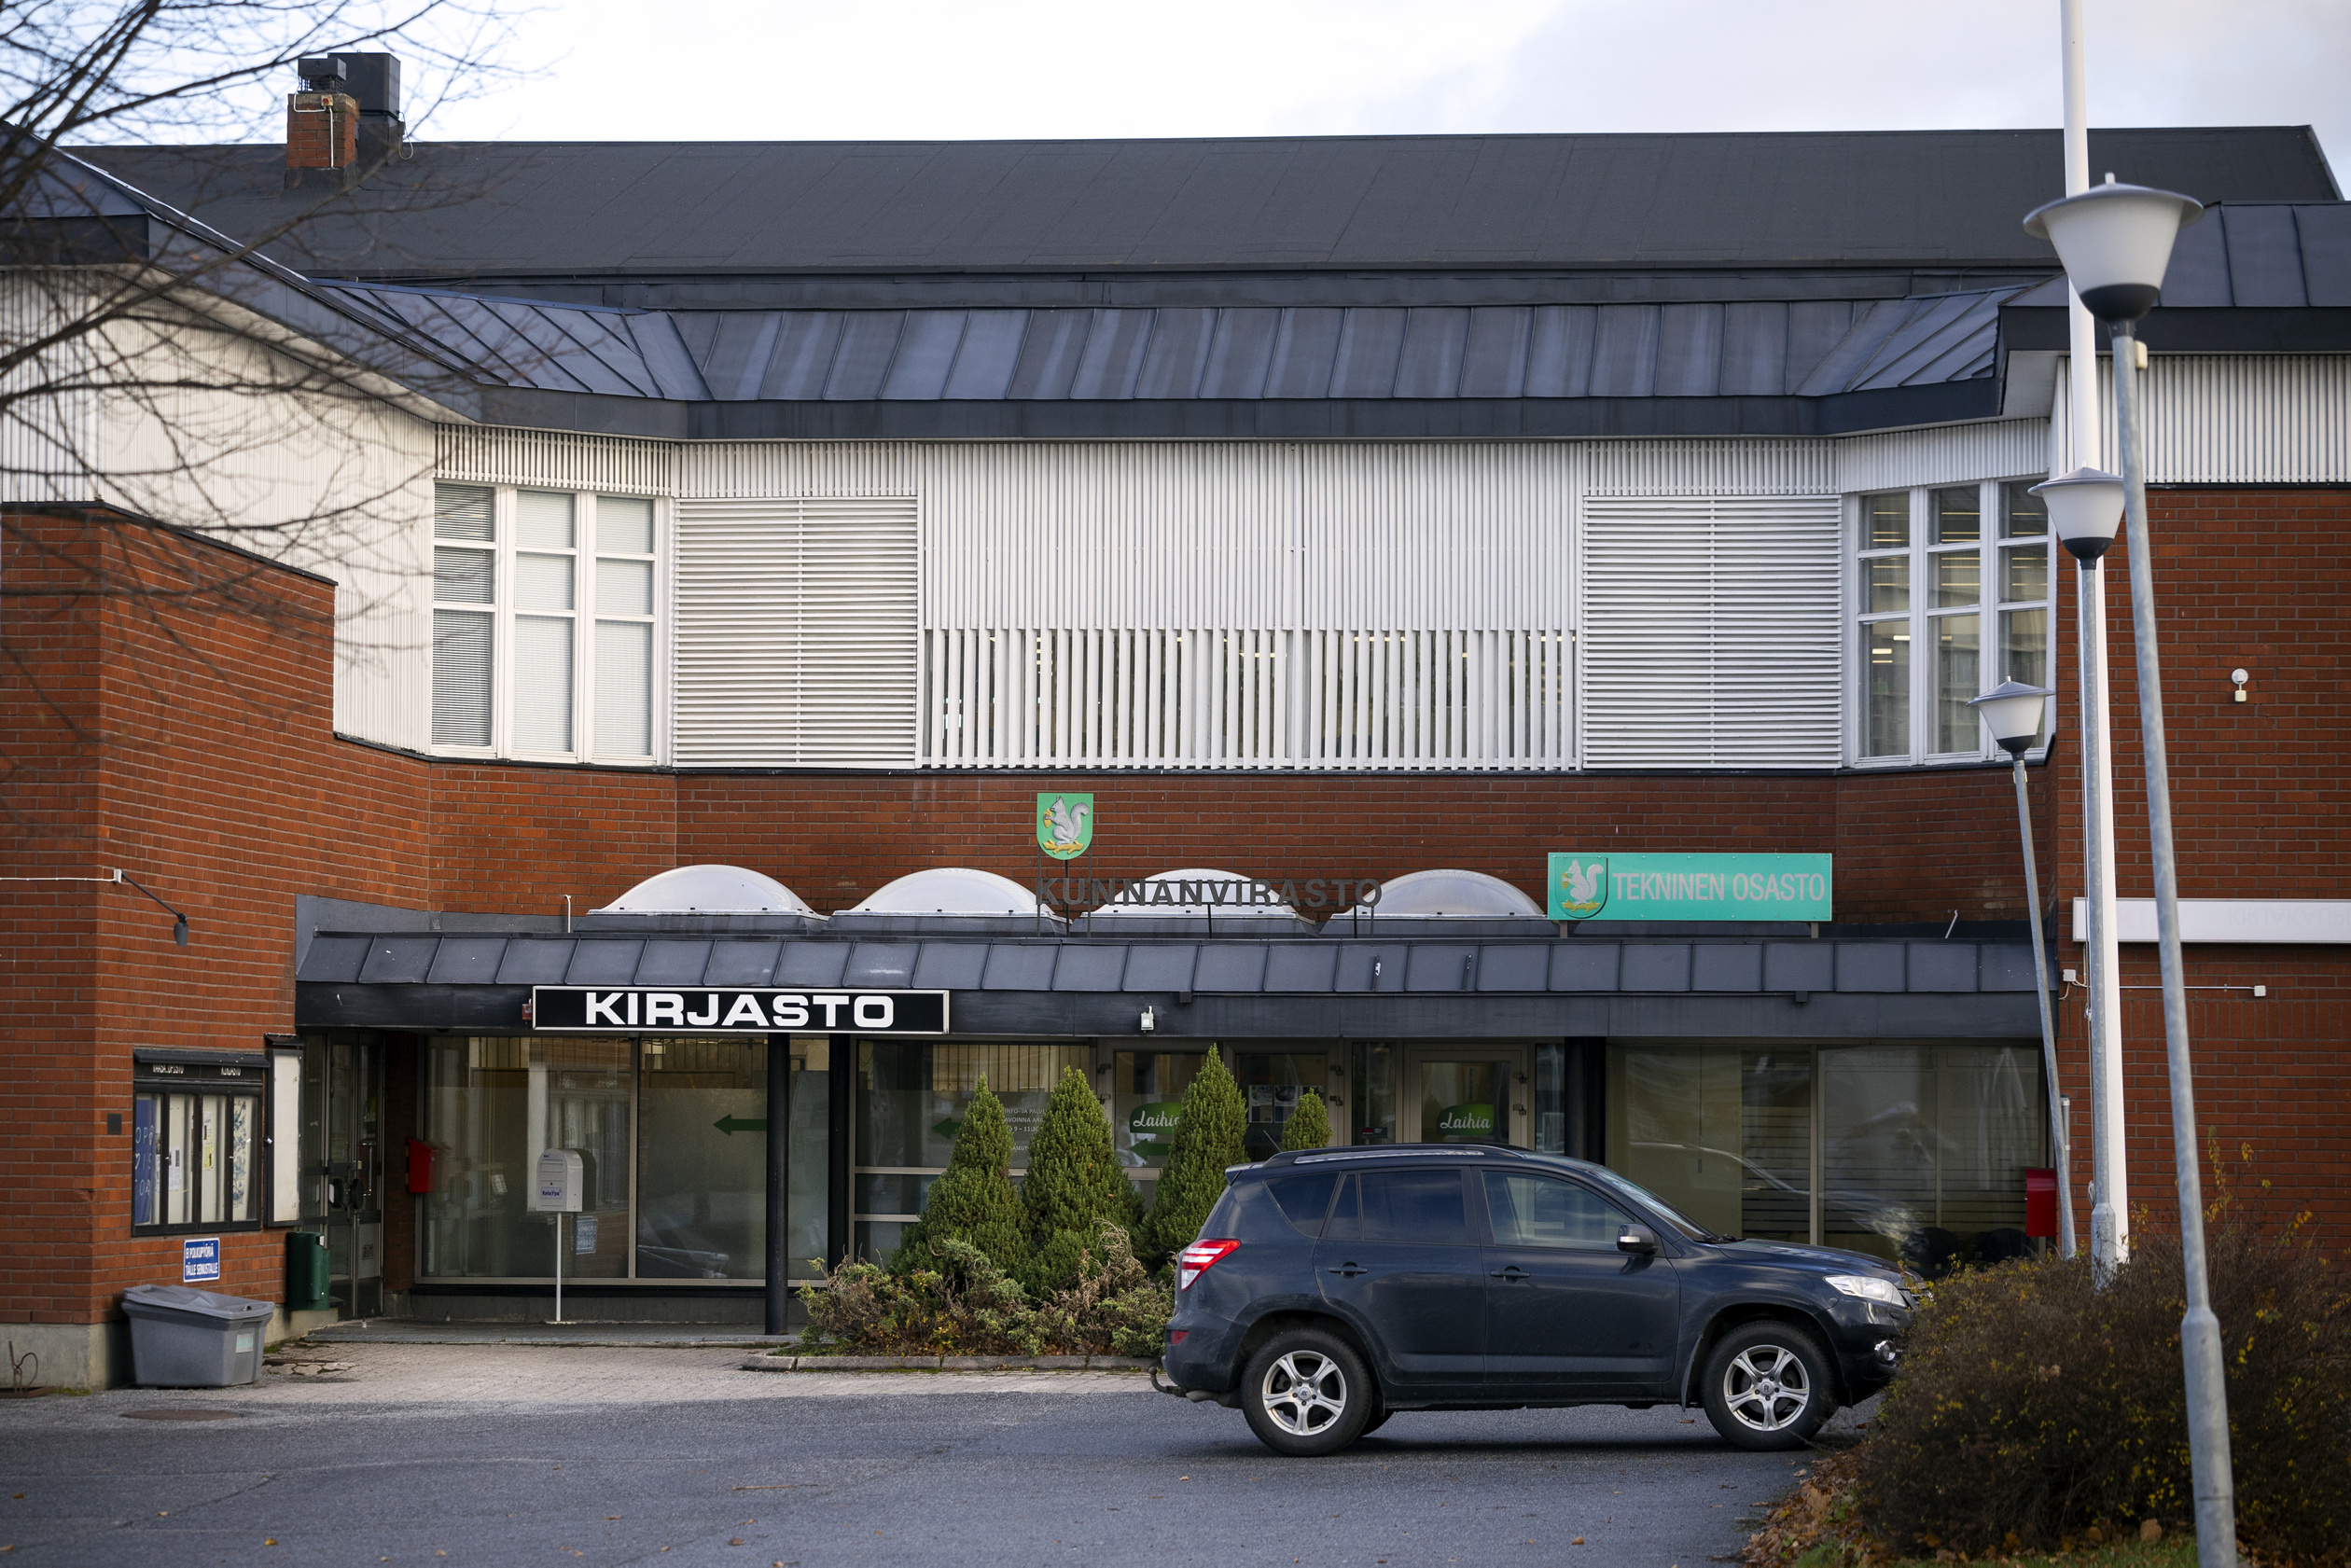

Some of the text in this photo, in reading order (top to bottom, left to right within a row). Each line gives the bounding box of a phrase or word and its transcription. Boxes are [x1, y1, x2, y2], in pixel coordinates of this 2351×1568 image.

[1036, 877, 1383, 908] KUNNANVIRASTO
[1612, 872, 1826, 902] TEKNINEN OSASTO
[585, 992, 894, 1028] KIRJASTO
[1440, 1112, 1491, 1129] Laihia
